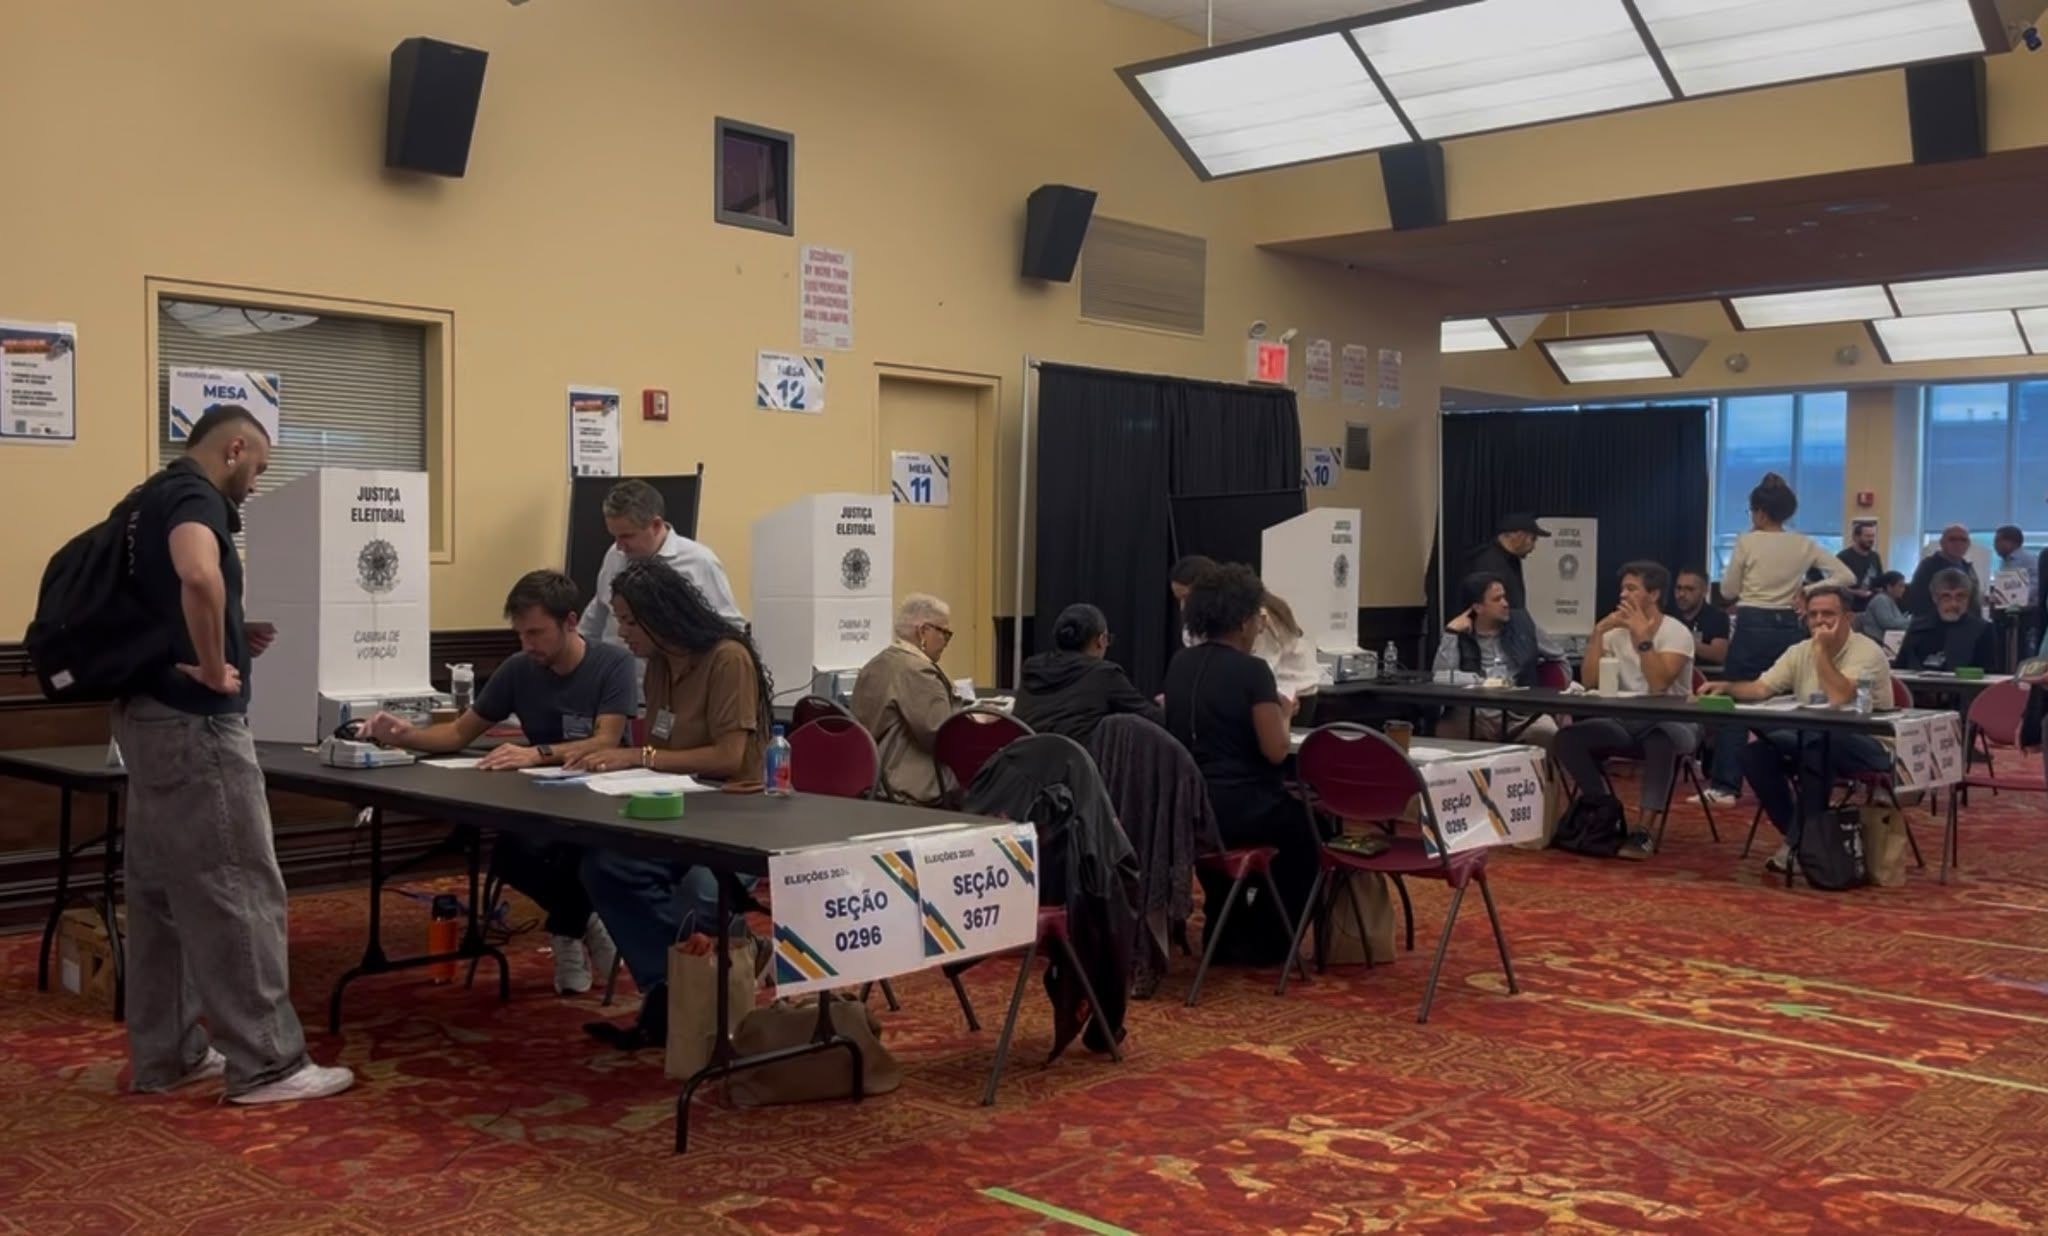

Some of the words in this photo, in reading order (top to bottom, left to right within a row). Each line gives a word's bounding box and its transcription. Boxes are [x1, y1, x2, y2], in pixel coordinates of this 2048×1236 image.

[203, 384, 248, 400] MESA
[777, 379, 805, 410] 12
[909, 463, 932, 474] MESA
[1314, 465, 1329, 487] 10
[357, 486, 401, 506] JUSTIÇA
[910, 477, 931, 503] 11
[351, 508, 405, 522] ELEITORAL
[841, 506, 873, 521] JUSTIÇA
[836, 523, 876, 535] ELEITORAL
[1506, 779, 1536, 802] SEÇÃO
[1442, 793, 1472, 814] SEÇÃO
[924, 850, 958, 865] ELEIÇÕES
[784, 868, 830, 886] ELEIÇÕES
[953, 865, 1010, 899] SEÇÃO
[825, 888, 888, 921] SEÇÃO
[963, 904, 1000, 930] 3677
[835, 926, 882, 952] 0296
